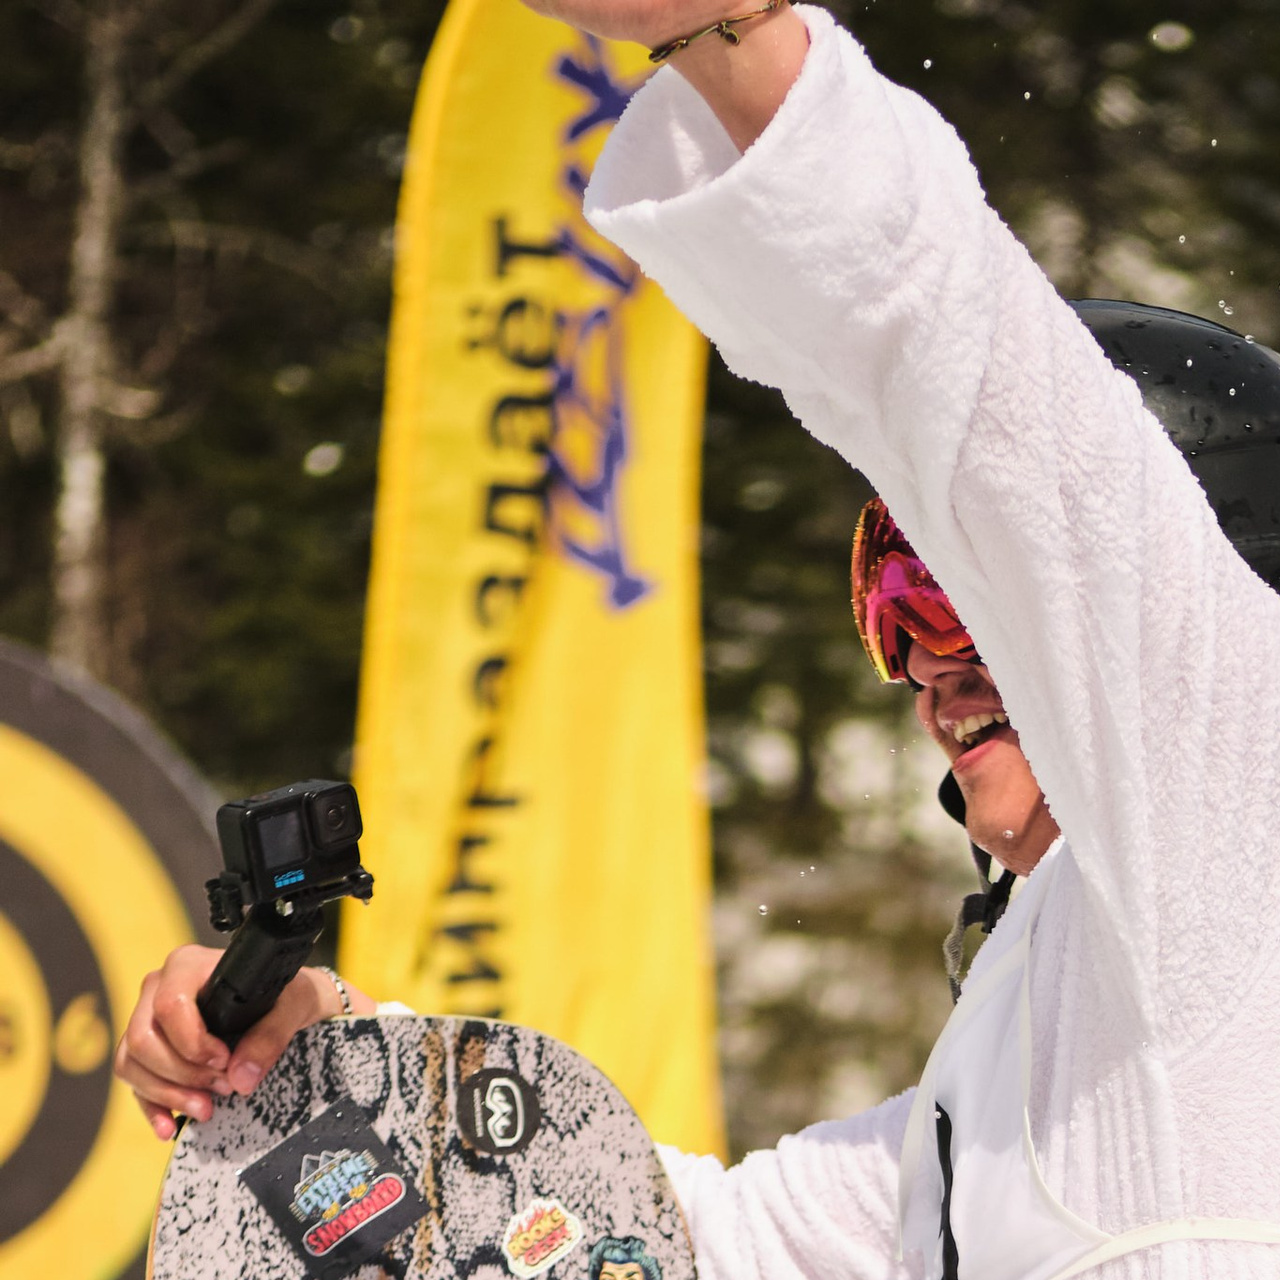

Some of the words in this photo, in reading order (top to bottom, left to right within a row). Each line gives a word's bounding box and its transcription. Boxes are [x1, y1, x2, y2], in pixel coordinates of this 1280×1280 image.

[273, 868, 305, 882] GoPro
[295, 1153, 369, 1217] EXTREME
[304, 1177, 403, 1254] SNOWBOARD
[507, 1207, 567, 1259] ROOKS
